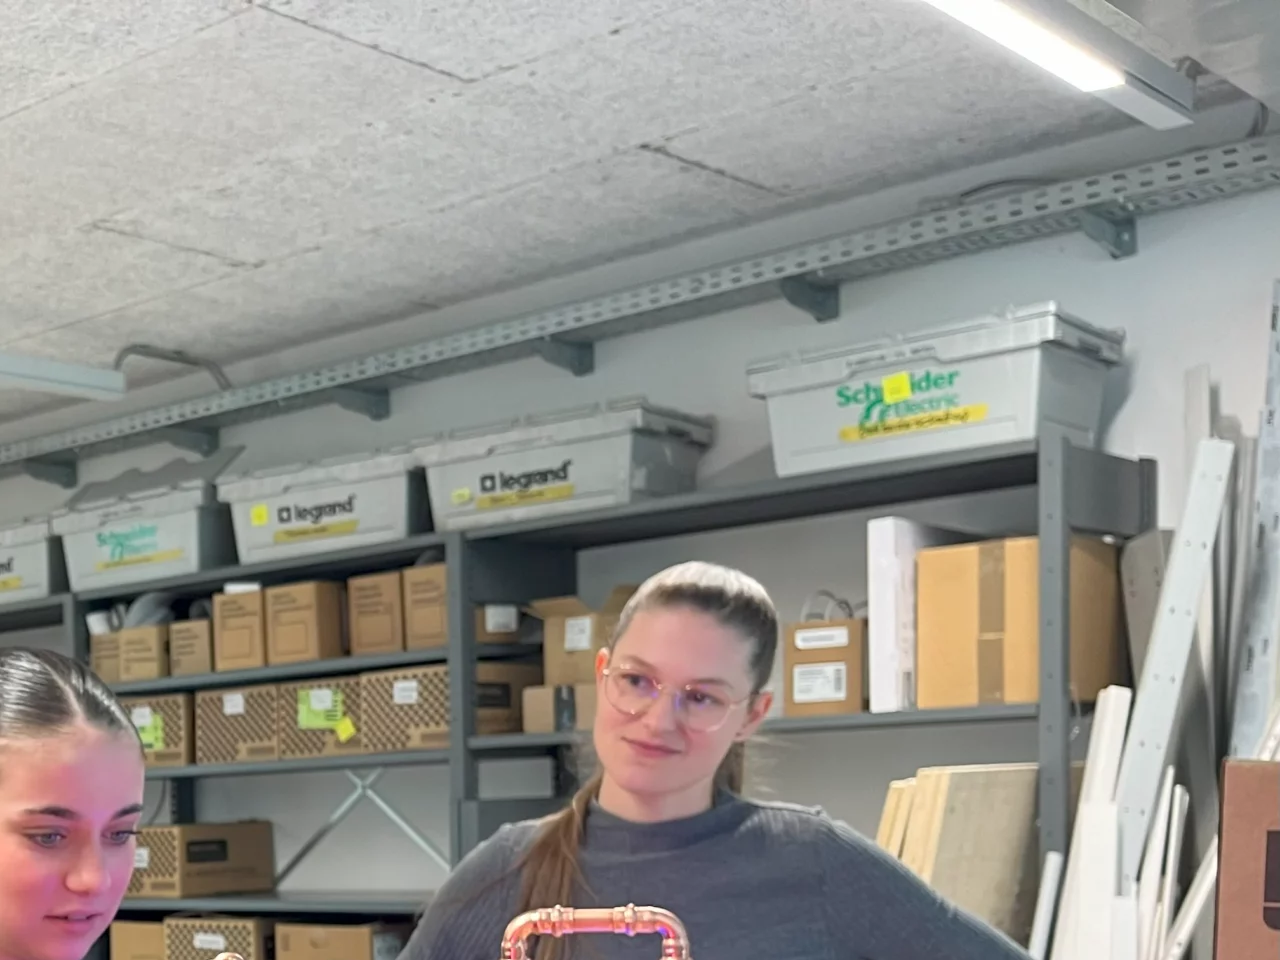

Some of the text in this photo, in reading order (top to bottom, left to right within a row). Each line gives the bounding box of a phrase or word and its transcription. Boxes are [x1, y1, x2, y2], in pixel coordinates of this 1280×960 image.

[836, 369, 960, 407] Schider
[500, 459, 572, 491] legrand
[294, 493, 356, 524] legrand
